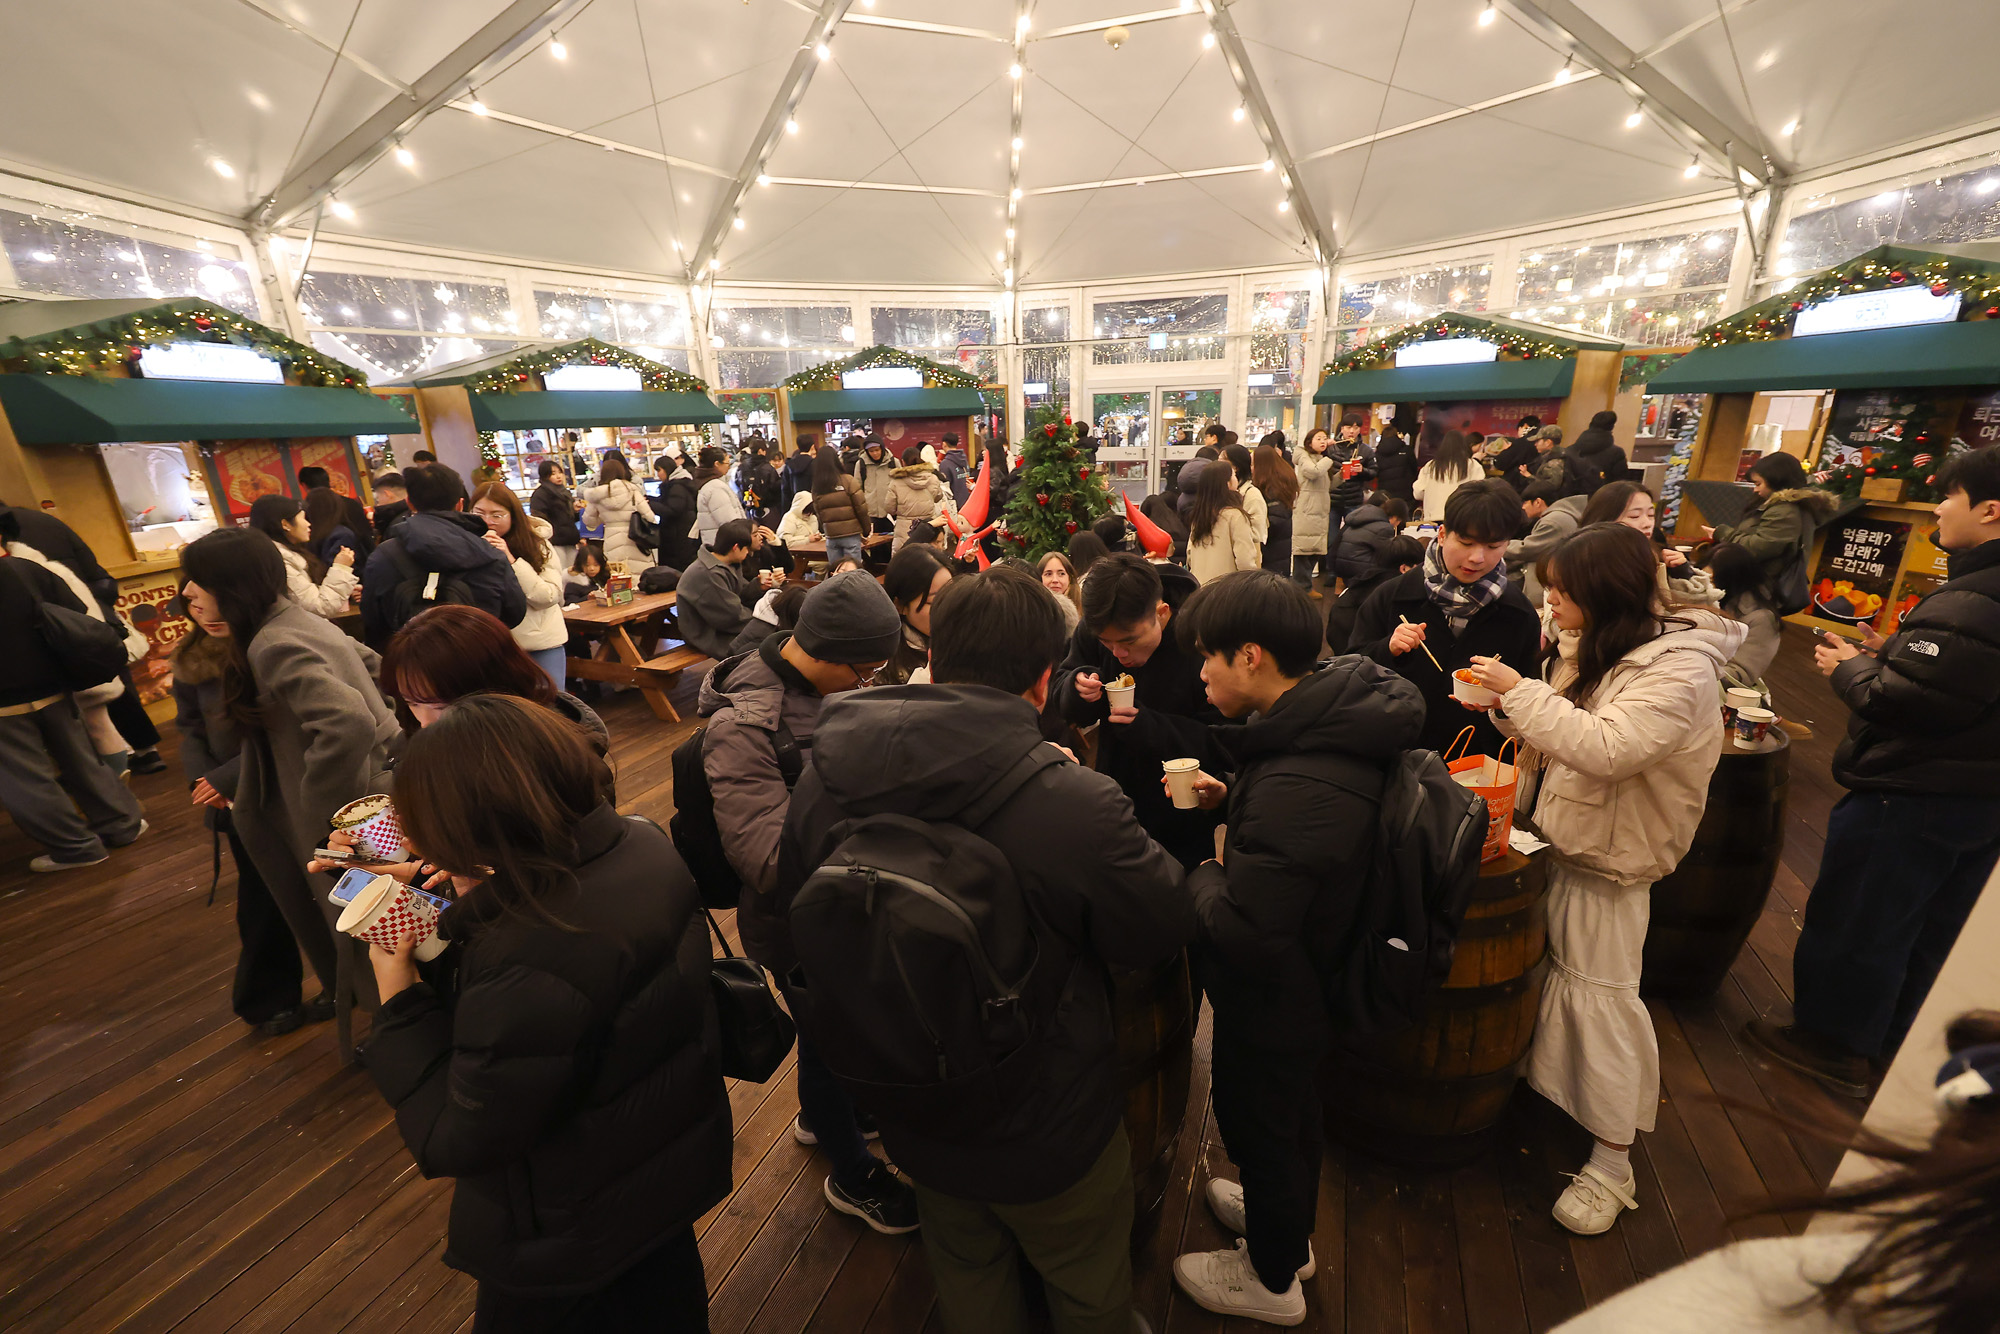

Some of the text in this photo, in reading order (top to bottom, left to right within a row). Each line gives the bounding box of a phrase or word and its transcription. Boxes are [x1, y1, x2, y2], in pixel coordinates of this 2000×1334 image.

[1979, 425, 2000, 440] 여
[1843, 528, 1892, 546] 먹을래?
[1843, 543, 1880, 560] 말래?
[1831, 556, 1885, 577] 뜨겁긴해
[1907, 642, 1930, 652] NORTH
